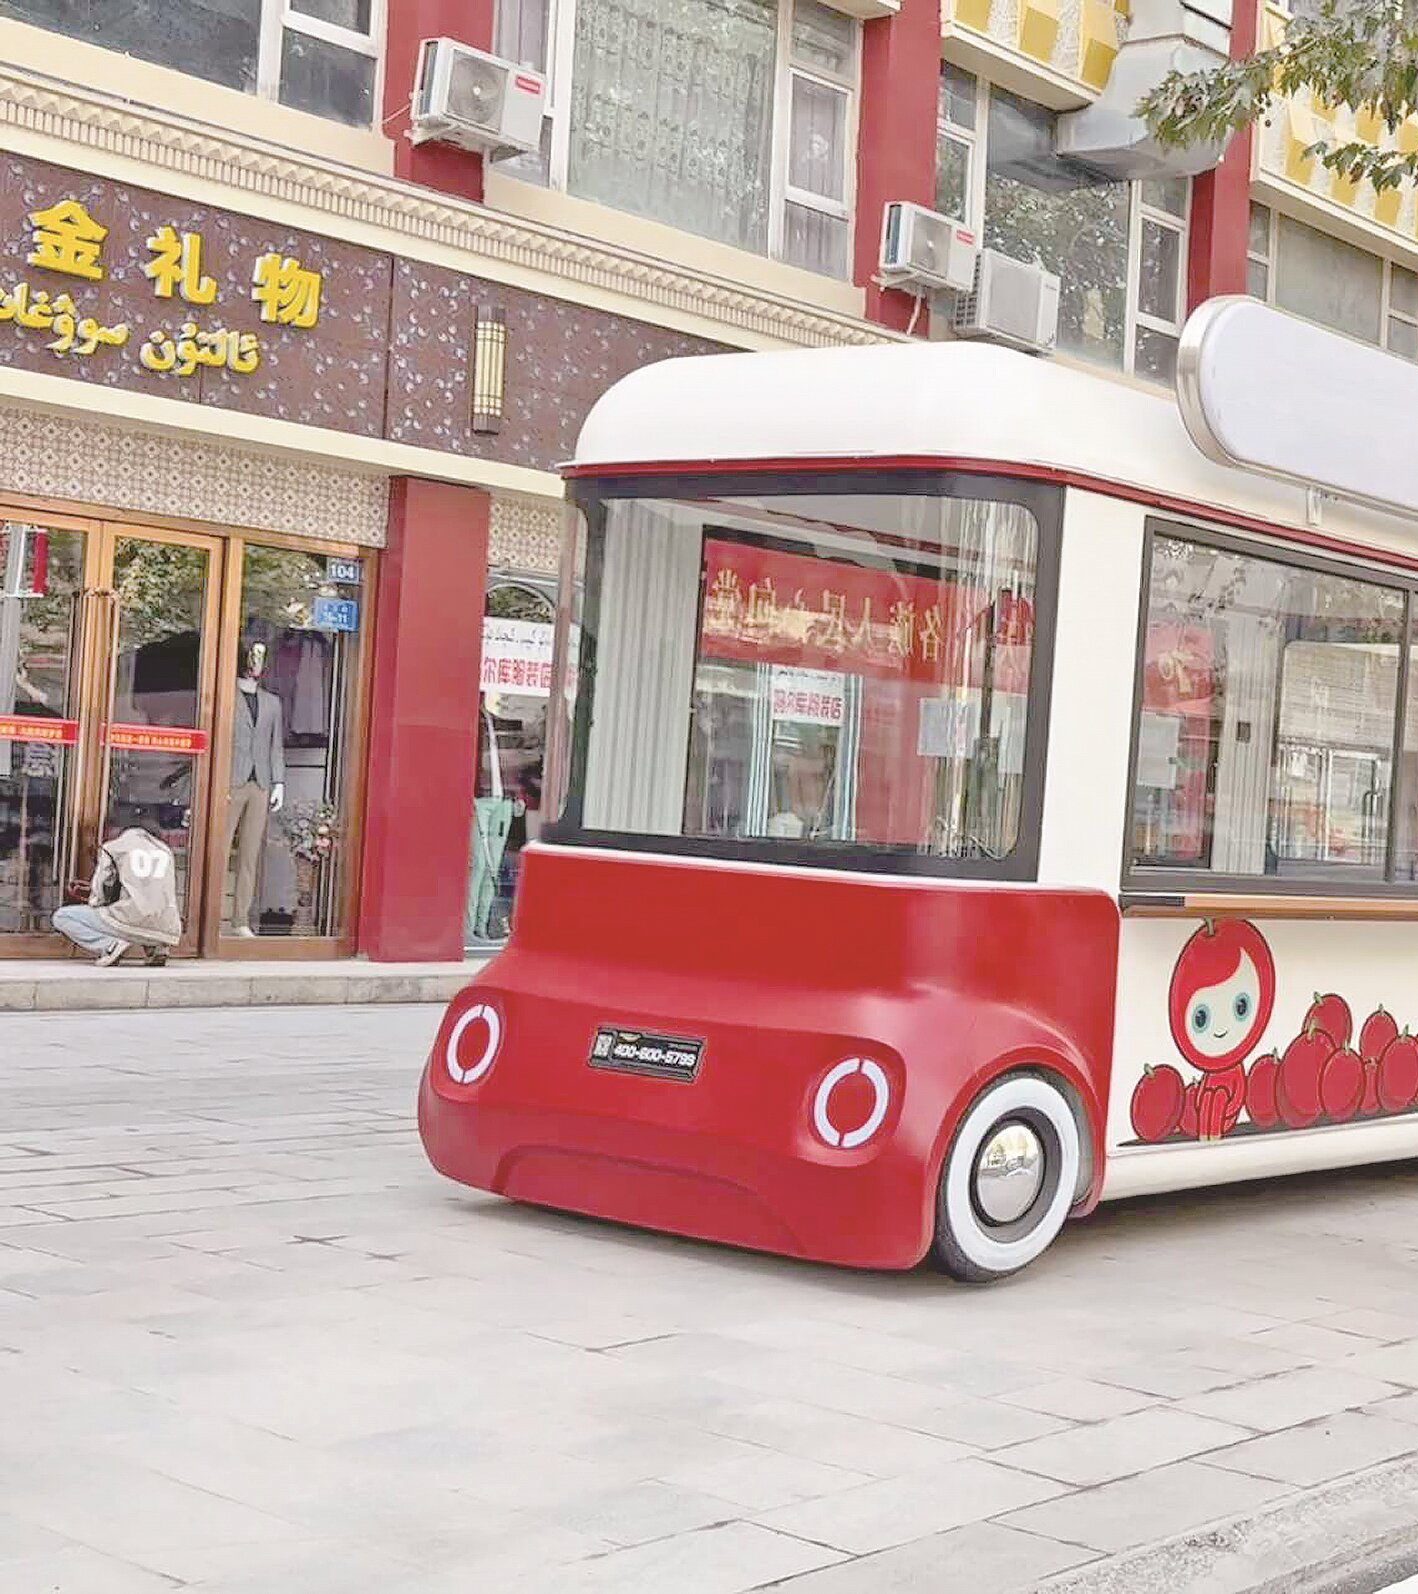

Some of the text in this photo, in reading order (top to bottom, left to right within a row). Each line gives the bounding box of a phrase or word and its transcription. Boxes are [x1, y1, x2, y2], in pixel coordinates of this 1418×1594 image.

[27, 199, 323, 329] 金礼物
[330, 564, 355, 579] 104
[130, 848, 168, 878] 07
